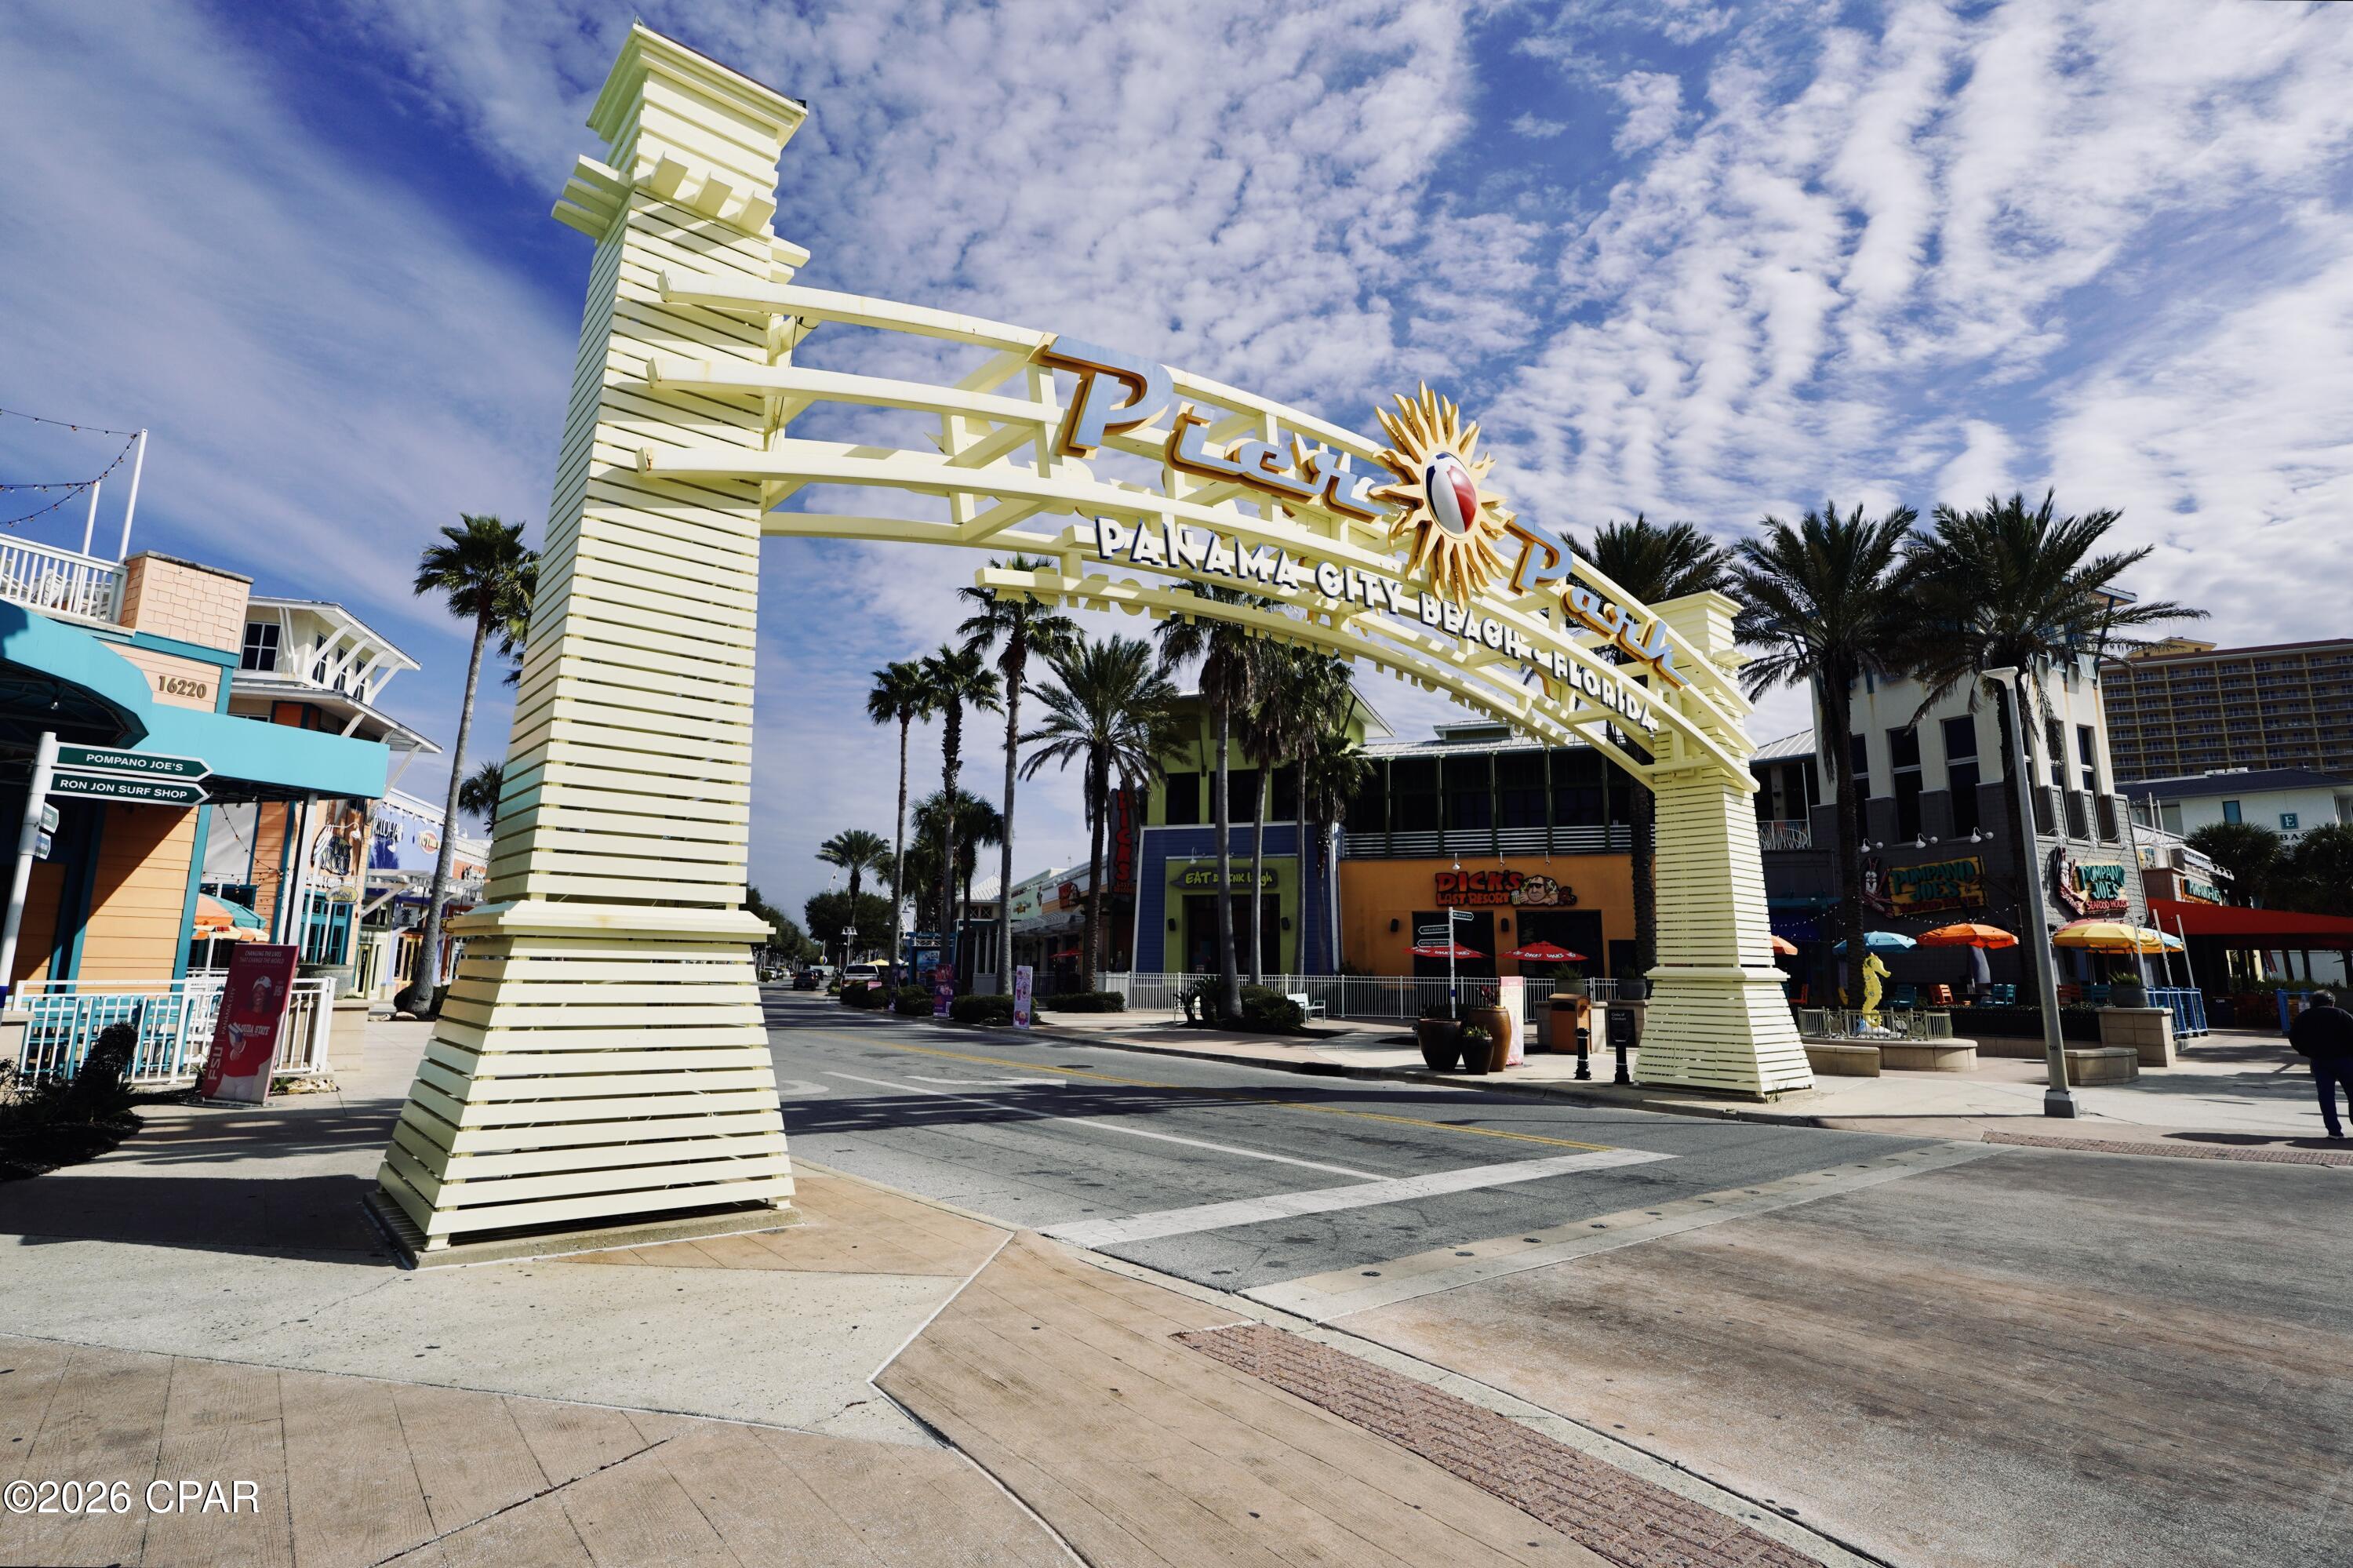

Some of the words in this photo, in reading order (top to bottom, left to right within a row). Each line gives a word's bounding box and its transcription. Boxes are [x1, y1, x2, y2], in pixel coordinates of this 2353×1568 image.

[1029, 333, 1387, 524] Pier
[1504, 515, 1689, 691] Park
[1095, 515, 1299, 589] PANAMA
[1315, 561, 1403, 614] CITY
[1419, 591, 1521, 659] BEACH
[1552, 649, 1659, 732] FLORIDA
[158, 675, 207, 699] 16220
[86, 754, 147, 767] POMPANO
[150, 760, 184, 771] JOE'S
[60, 779, 88, 789] RON
[90, 782, 115, 792] JON
[118, 785, 151, 795] SURF
[154, 788, 187, 799] SHOP
[1185, 871, 1211, 884] EAT
[1435, 871, 1524, 891] DICK'S
[1889, 861, 1974, 894] POMPANO
[1437, 892, 1466, 905] LAST
[1468, 893, 1510, 904] RESORT
[2086, 900, 2110, 910] SEAFOOD
[208, 1046, 224, 1080] FSU
